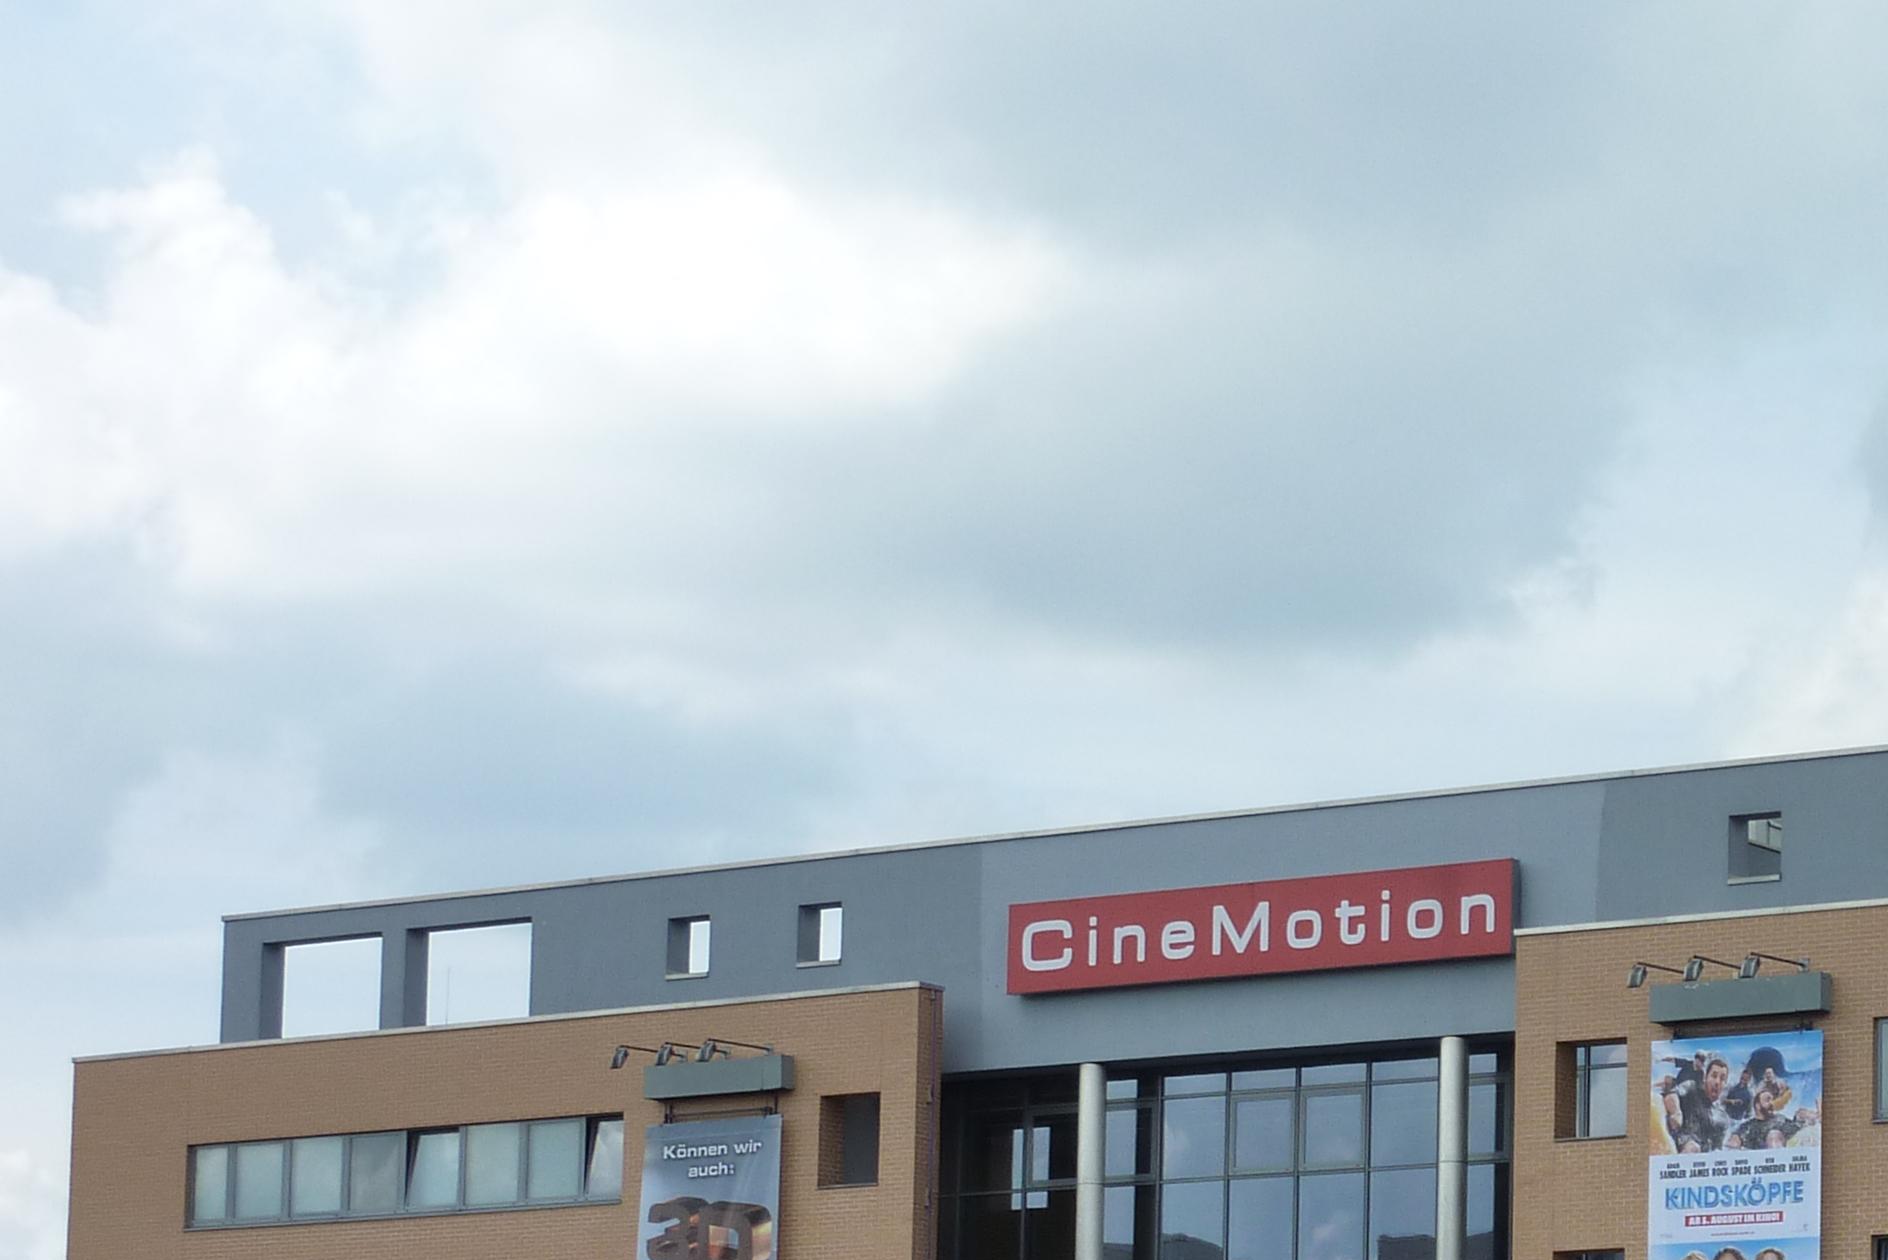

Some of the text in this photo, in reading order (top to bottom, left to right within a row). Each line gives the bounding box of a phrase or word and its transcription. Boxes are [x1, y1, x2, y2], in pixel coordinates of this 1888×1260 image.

[1021, 889, 1496, 972] CineMotion
[663, 1140, 762, 1160] Können wir
[688, 1162, 735, 1178] auch:
[1660, 1169, 1687, 1179] SANDLER
[1689, 1168, 1710, 1178] JAMES
[1712, 1167, 1729, 1177] ROCK
[1731, 1166, 1751, 1175] SPADE
[1754, 1164, 1786, 1174] SCHNEIDER
[1665, 1177, 1805, 1210] KINDSKÖPFE
[1711, 1213, 1743, 1224] AUGUST
